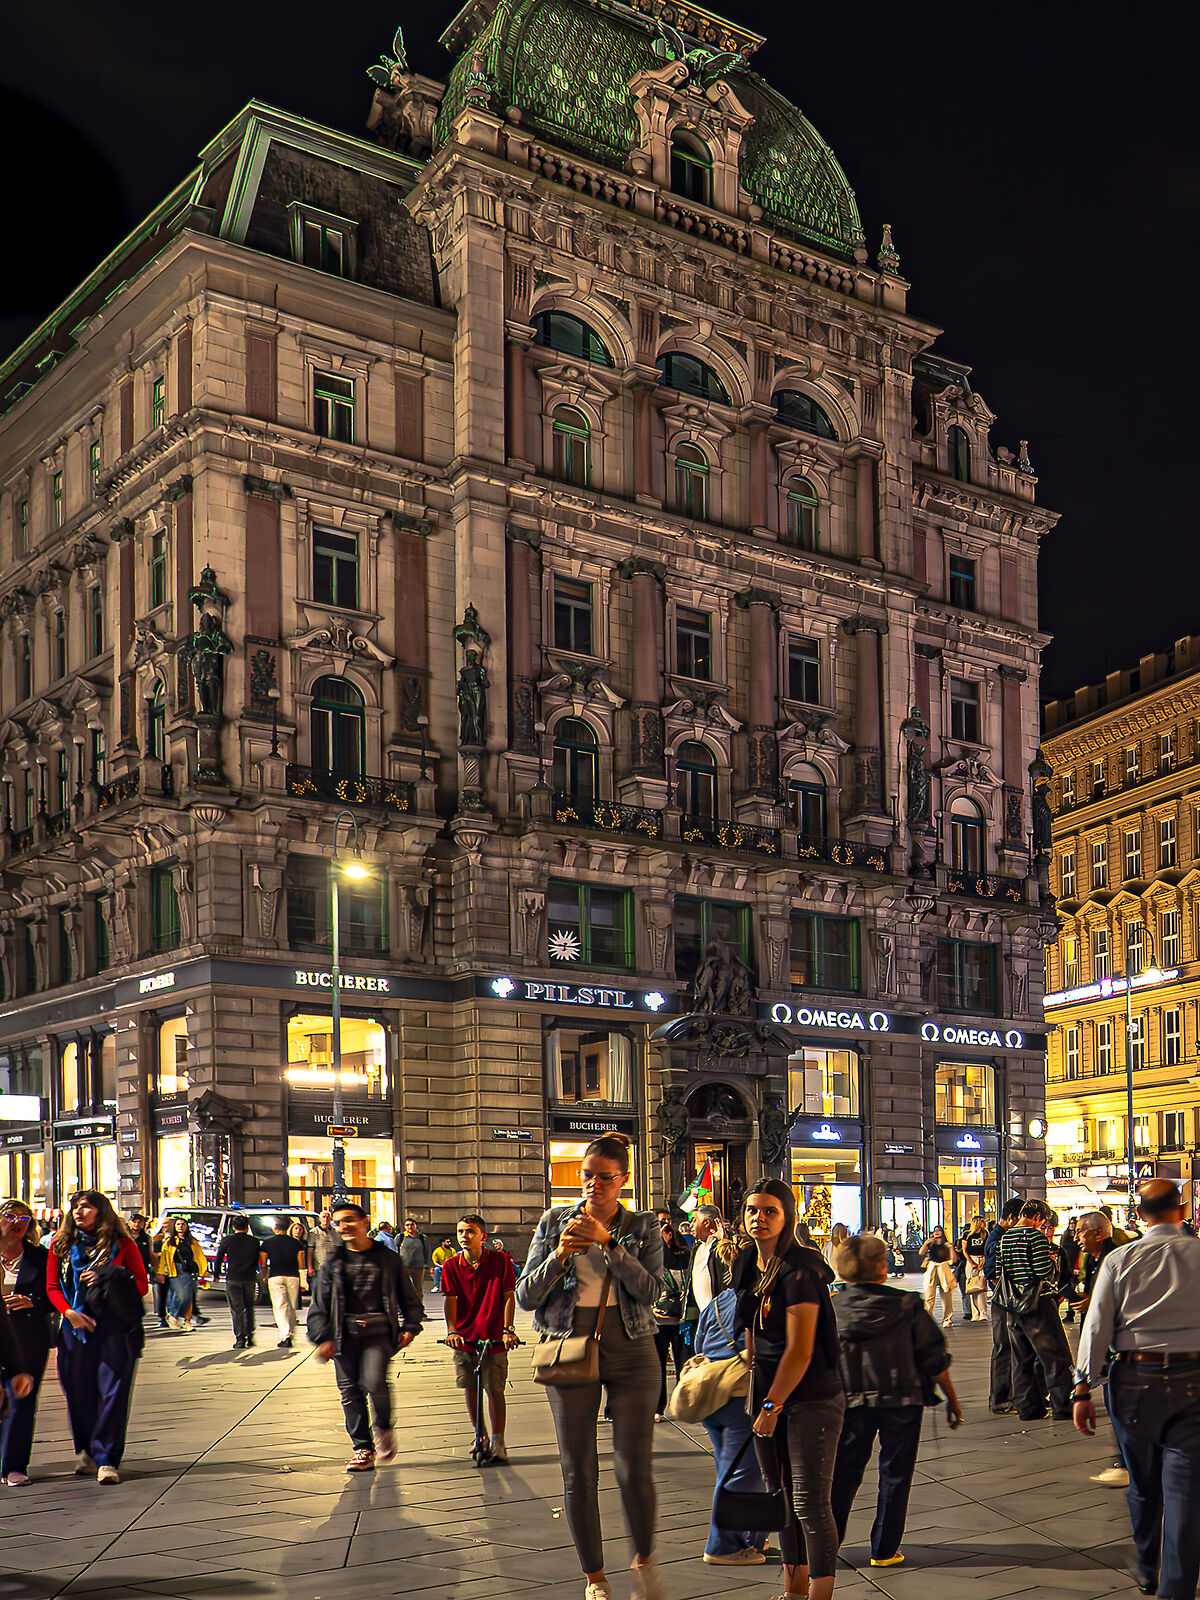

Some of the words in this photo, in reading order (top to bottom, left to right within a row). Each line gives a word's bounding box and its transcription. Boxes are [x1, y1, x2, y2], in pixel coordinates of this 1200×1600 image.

[524, 982, 633, 1008] PILSTL
[797, 1008, 865, 1030] OMEGA
[943, 1027, 1002, 1047] OMEGA
[314, 1114, 369, 1124] BUCERER
[570, 1121, 618, 1131] BUCHERER
